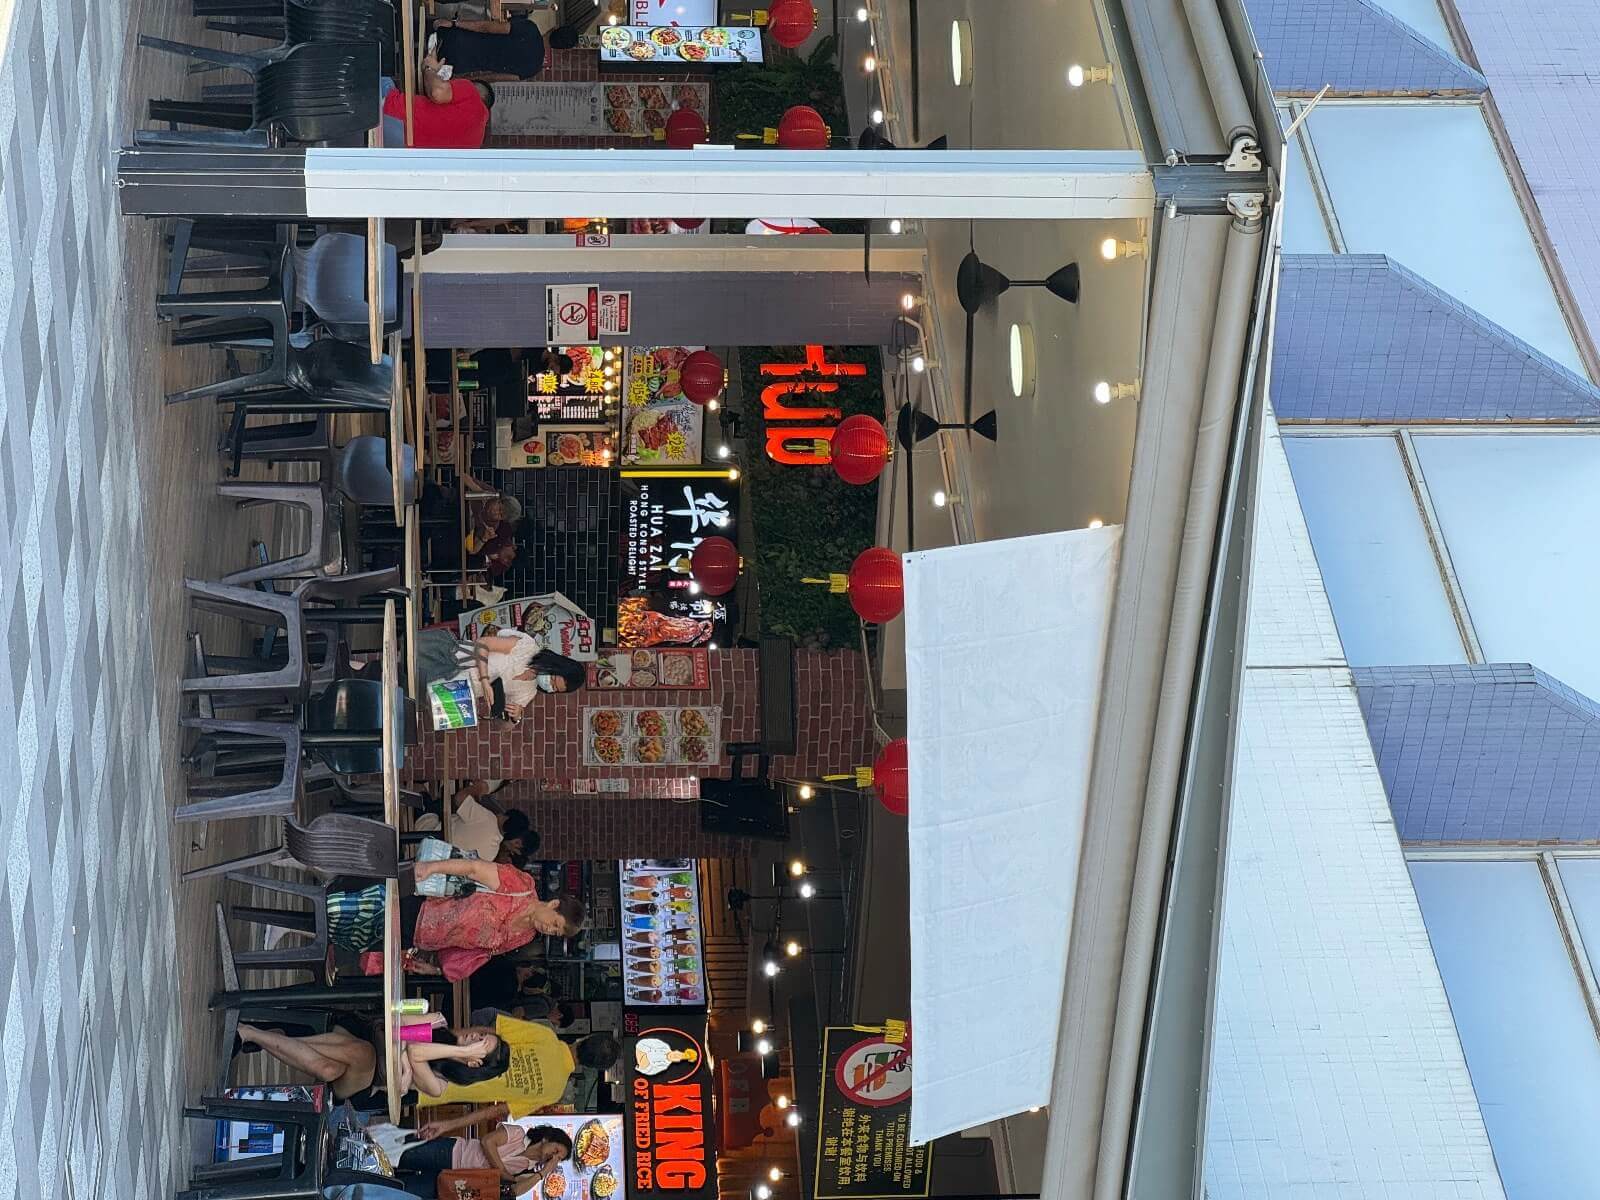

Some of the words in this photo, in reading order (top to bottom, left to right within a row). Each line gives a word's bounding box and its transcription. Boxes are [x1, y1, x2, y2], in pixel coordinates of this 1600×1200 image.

[640, 484, 649, 517] HONG
[628, 500, 638, 538] ROASTED
[650, 504, 664, 537] HUA
[639, 523, 648, 554] KONG
[628, 540, 637, 576] DELIGHT
[649, 545, 662, 572] ZAI
[638, 560, 647, 590] STYLE
[634, 1078, 649, 1100] OF
[634, 1102, 650, 1149] FRIED
[886, 1122, 894, 1137] THIS
[898, 1114, 906, 1123] TO
[898, 1124, 906, 1133] BE
[653, 1083, 706, 1189] KING
[854, 1114, 871, 1183] 外来食物与饮料
[874, 1130, 884, 1152] THANK
[873, 1152, 882, 1167] YOU
[894, 1133, 905, 1171] CONSUMED
[915, 1150, 924, 1168] FOOD
[636, 1151, 652, 1190] RICE
[893, 1172, 902, 1182] ON
[902, 1158, 913, 1189] ALLOWED
